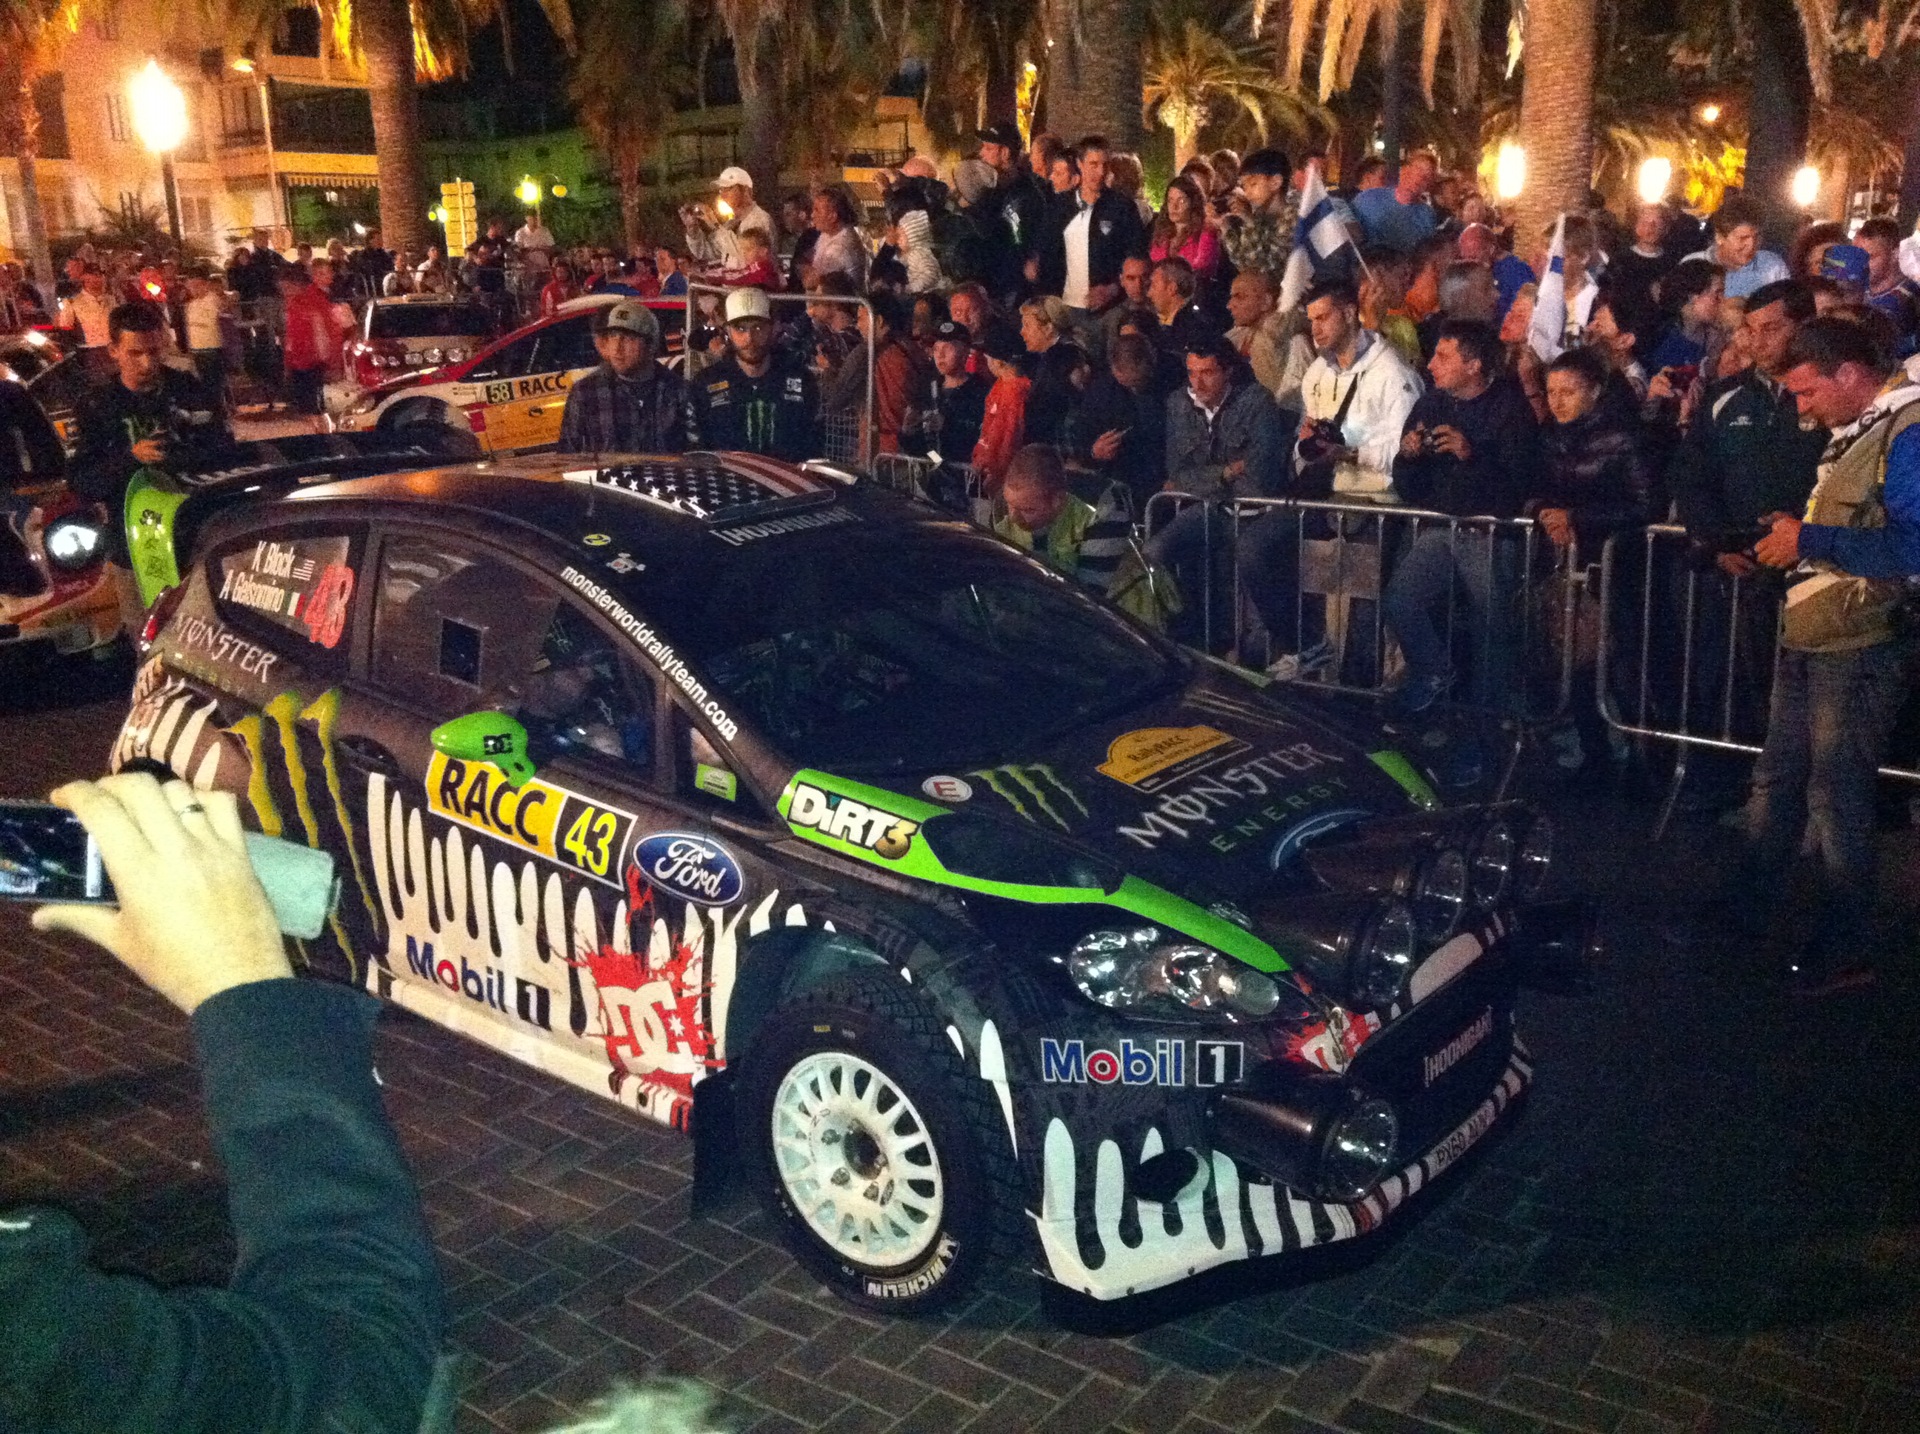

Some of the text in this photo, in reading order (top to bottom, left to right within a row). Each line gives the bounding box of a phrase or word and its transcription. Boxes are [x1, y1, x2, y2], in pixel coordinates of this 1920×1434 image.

[491, 383, 511, 403] 58
[519, 375, 567, 397] RACC
[219, 571, 286, 613] A Gelsomino
[252, 540, 295, 579] K Block
[560, 564, 739, 742] monsterworldrallyteam.com
[439, 757, 547, 846] RACC
[1208, 775, 1349, 854] ENERGY
[564, 805, 617, 877] 43
[653, 840, 727, 900] Ford
[406, 934, 508, 1014] Mobil
[599, 978, 697, 1074] DC
[1040, 1037, 1186, 1087] Mobil
[867, 1257, 948, 1298] MICHELIN
